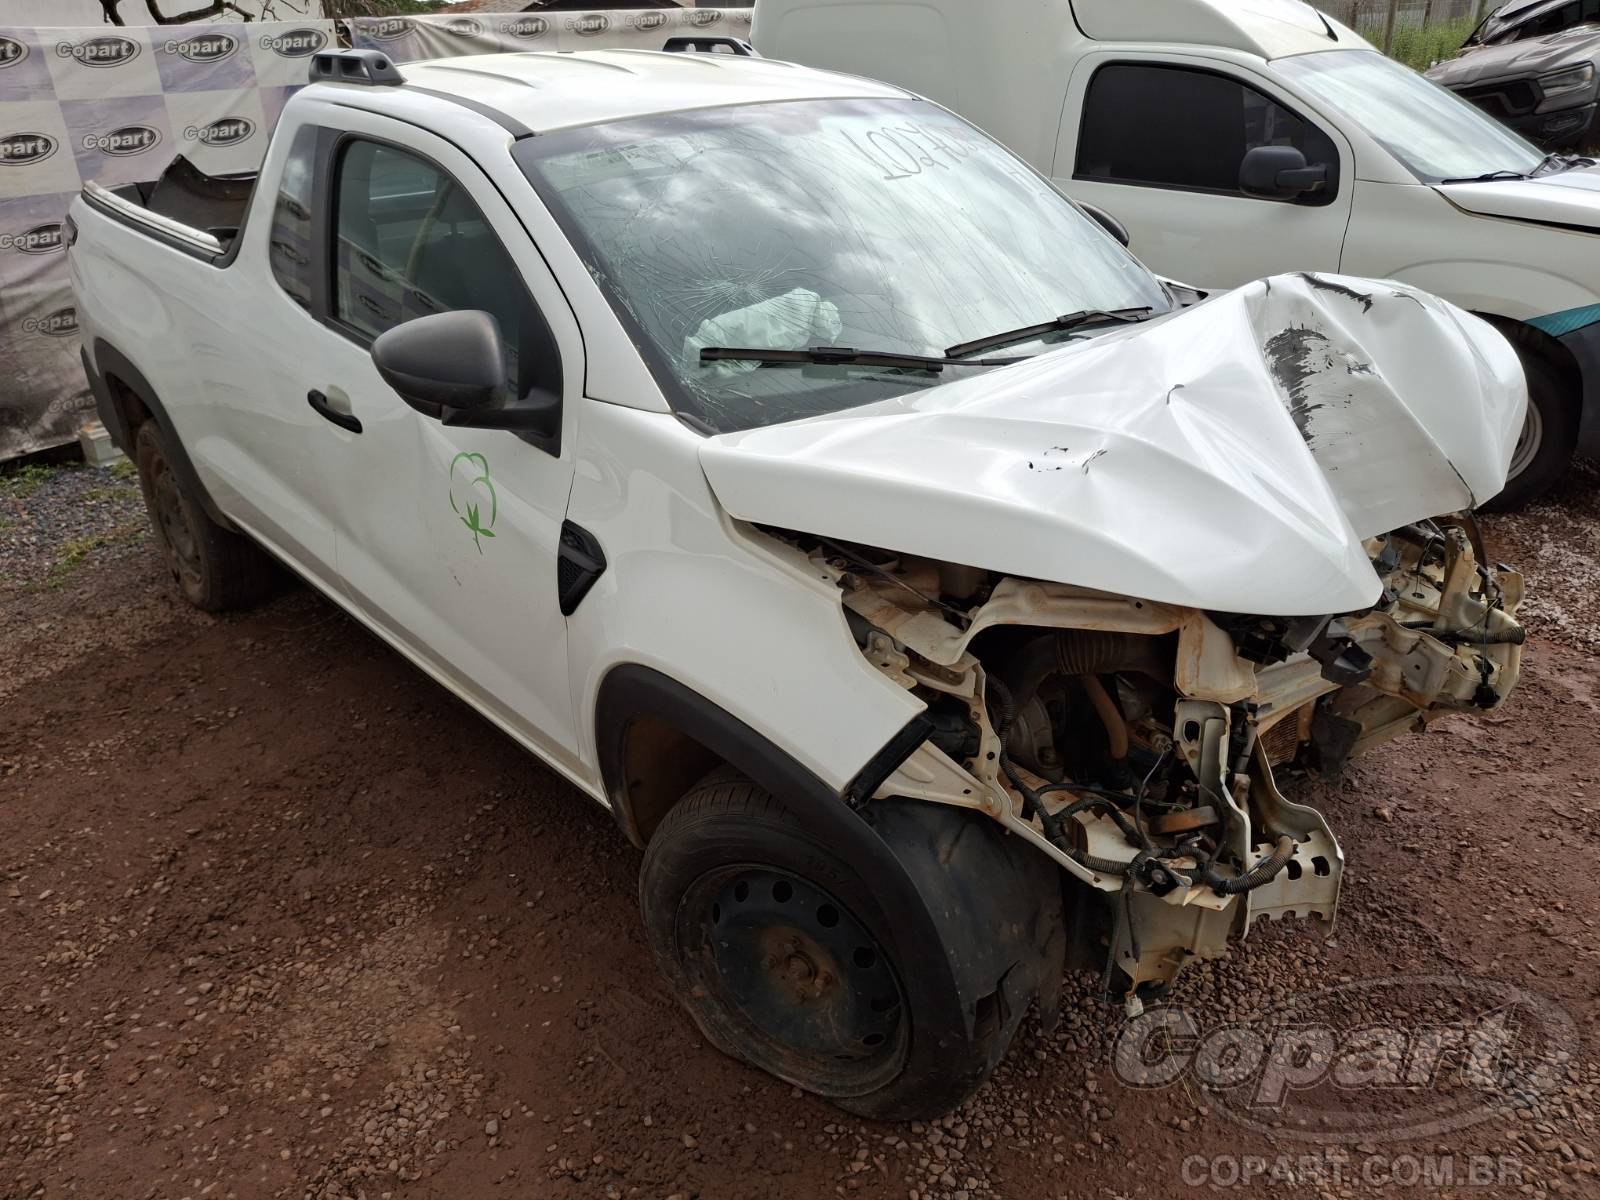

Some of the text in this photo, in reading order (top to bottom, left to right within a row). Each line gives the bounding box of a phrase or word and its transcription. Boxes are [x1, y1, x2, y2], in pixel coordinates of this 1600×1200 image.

[500, 21, 543, 34] Copart
[625, 15, 665, 28] Copart
[56, 41, 130, 60] Copart
[164, 37, 230, 57] Copart
[260, 33, 319, 49] Copart
[82, 130, 152, 150] Copart
[184, 122, 246, 141] Copart
[0, 138, 46, 159] part
[0, 230, 62, 250] Copar
[22, 314, 77, 333] Copa
[48, 394, 97, 413] Copa
